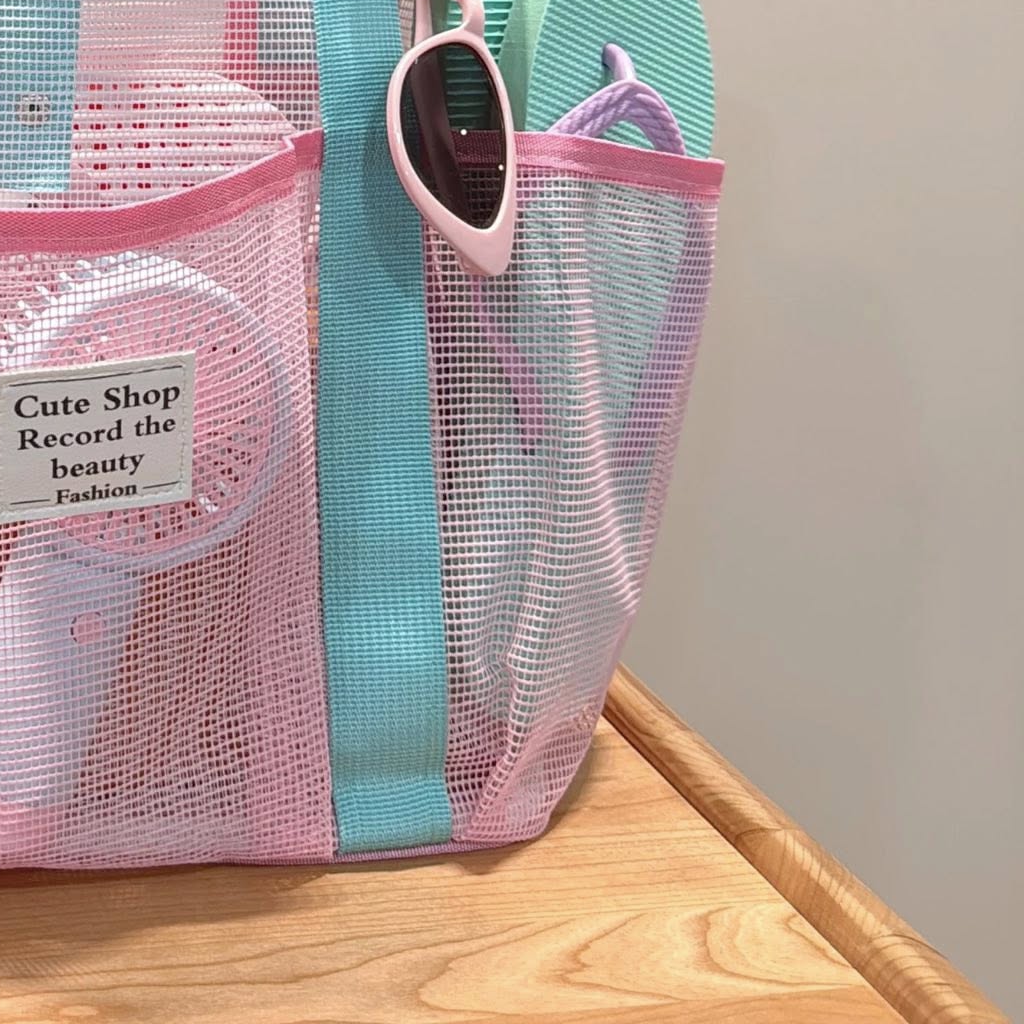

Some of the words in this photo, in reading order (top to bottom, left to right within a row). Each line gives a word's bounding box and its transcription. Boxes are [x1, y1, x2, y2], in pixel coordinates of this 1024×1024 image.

[14, 394, 91, 419] Cute
[103, 384, 181, 412] Shop
[17, 419, 124, 451] Record
[134, 415, 177, 438] the
[51, 453, 145, 480] beauty
[56, 483, 138, 505] Fashion
